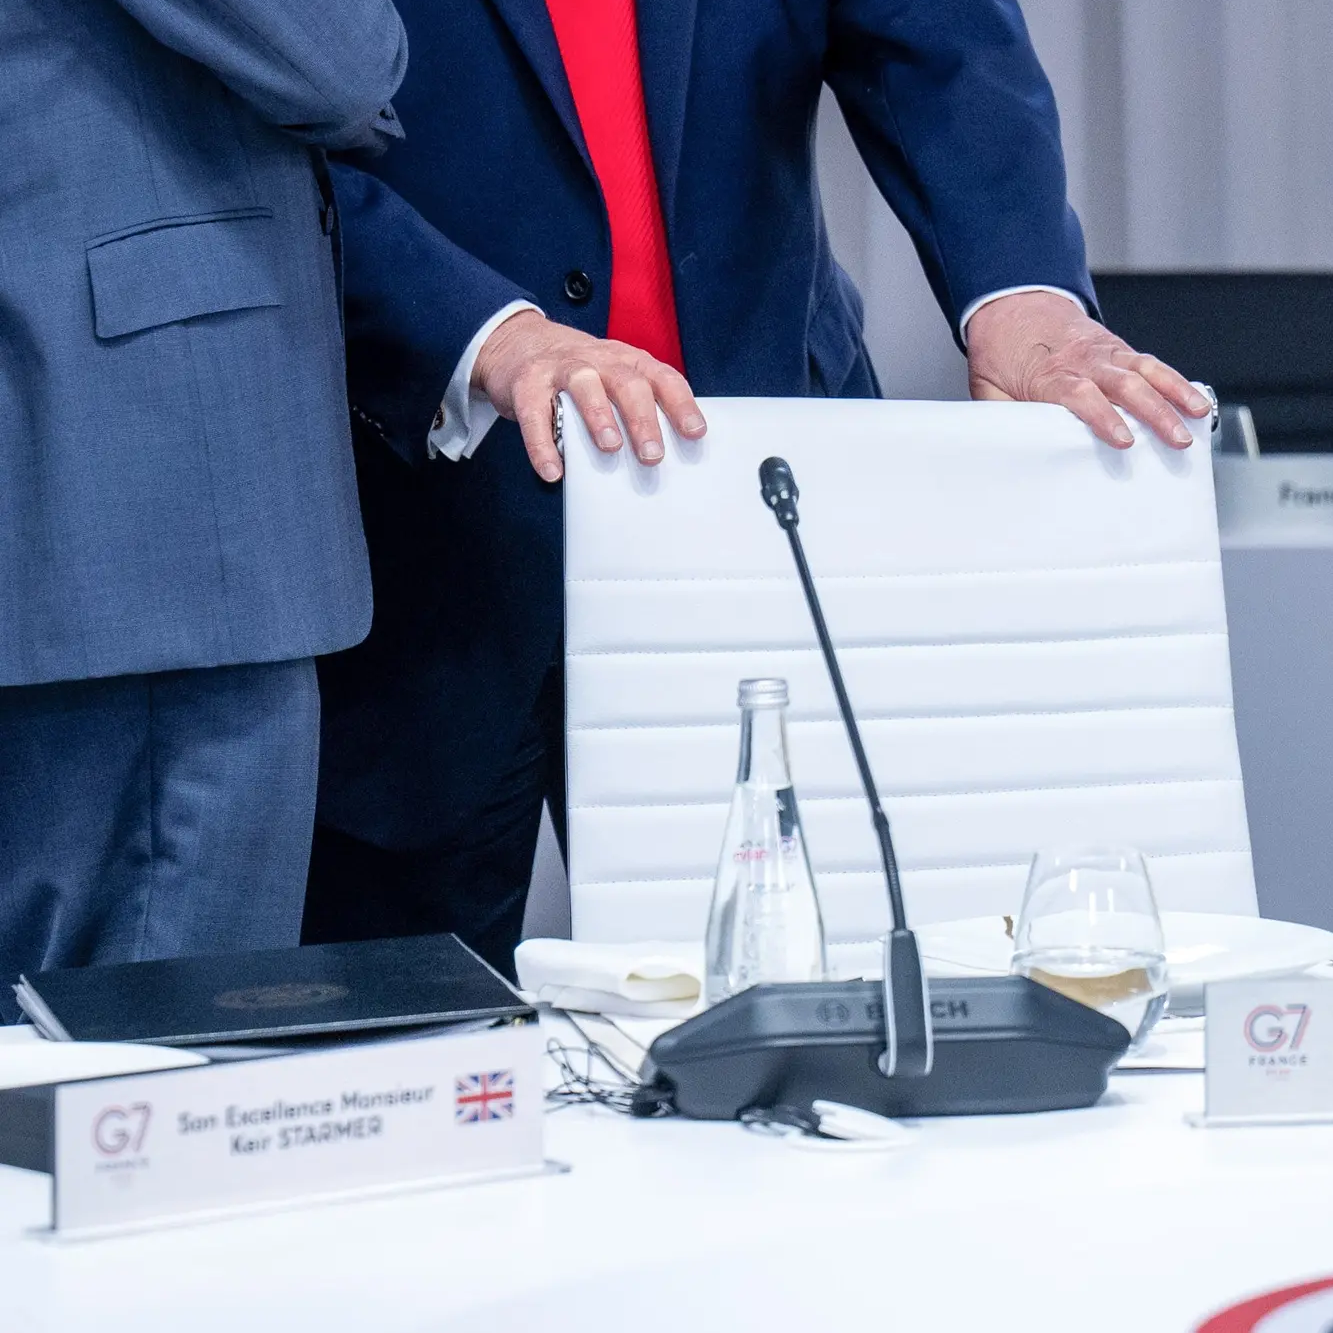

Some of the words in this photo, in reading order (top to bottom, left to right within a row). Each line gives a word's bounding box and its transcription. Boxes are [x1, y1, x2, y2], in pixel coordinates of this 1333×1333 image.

[865, 999, 969, 1019] BCH
[1243, 1003, 1312, 1053] G7
[91, 1101, 153, 1157] G7
[177, 1112, 218, 1135] Son
[224, 1100, 334, 1128] Excellence
[340, 1084, 435, 1111] Monsieur
[230, 1133, 272, 1155] Keir
[278, 1115, 383, 1150] STARMER
